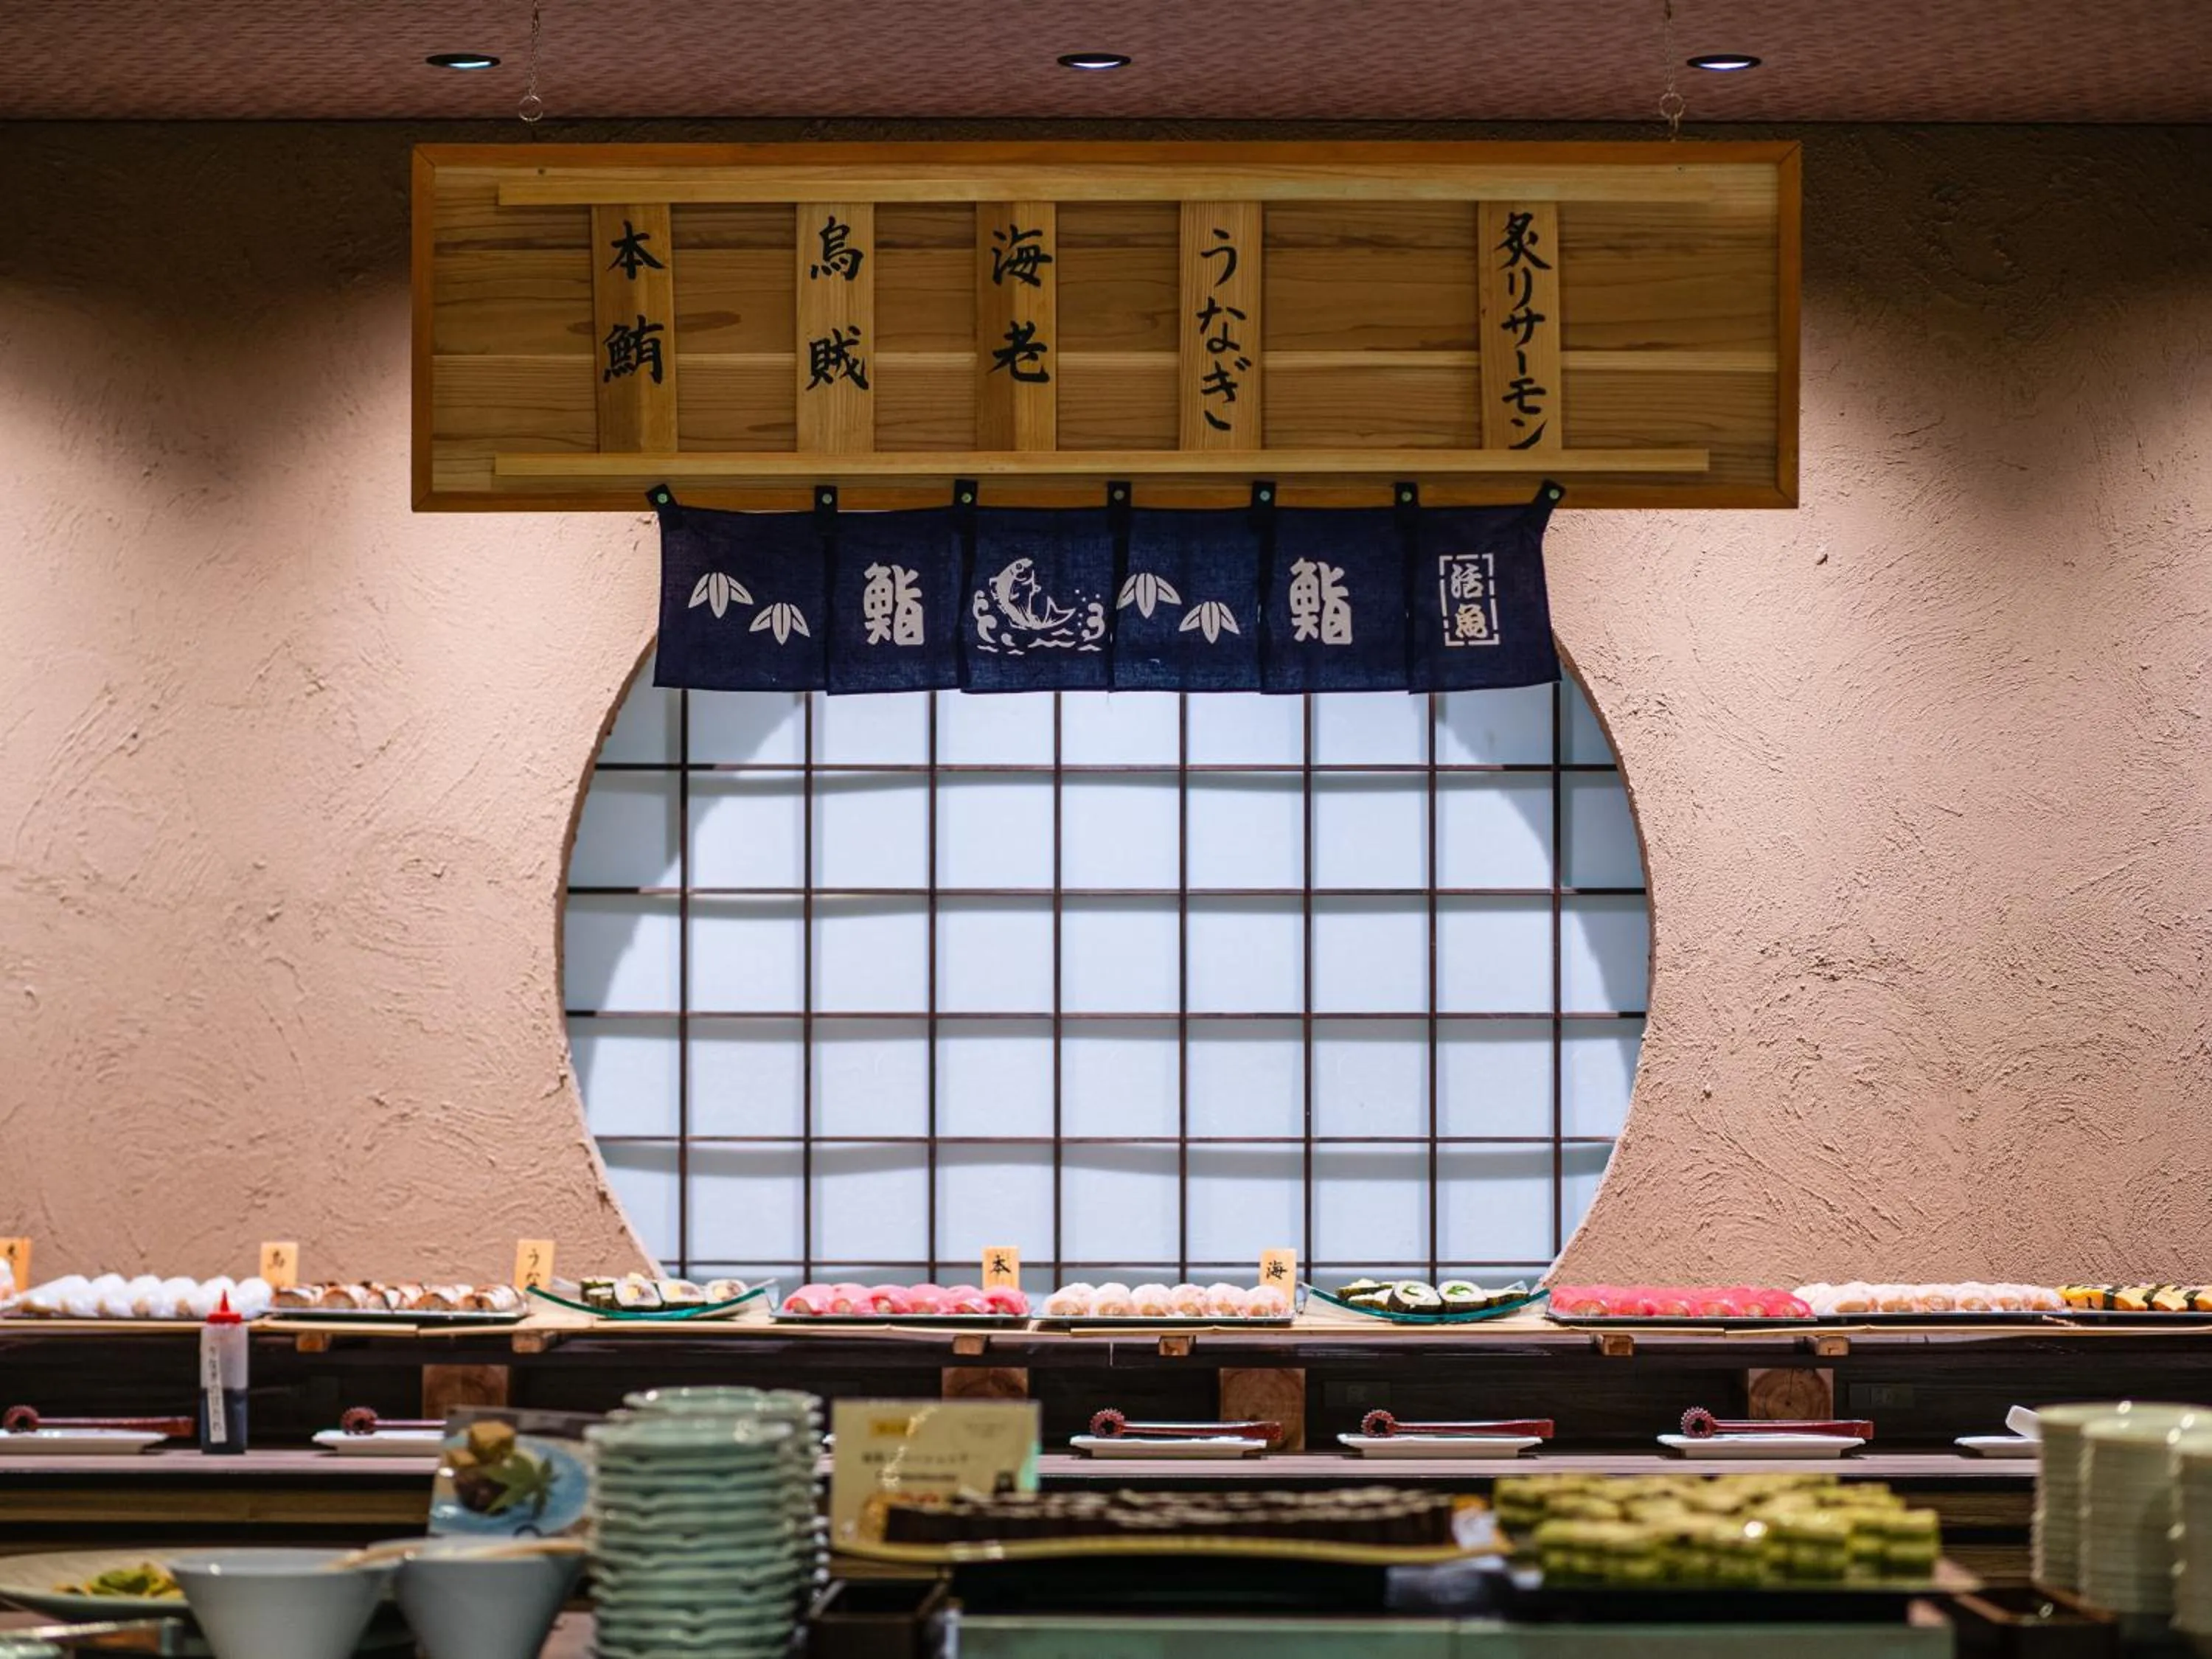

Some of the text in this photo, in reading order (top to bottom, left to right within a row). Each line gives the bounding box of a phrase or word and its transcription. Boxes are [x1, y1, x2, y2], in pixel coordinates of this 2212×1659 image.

[601, 218, 666, 386] 本鮪
[806, 215, 870, 391] 烏賊
[987, 223, 1054, 384] 海老
[1195, 228, 1253, 433] うなぎ
[1494, 210, 1553, 451] 炙りサーモン
[863, 561, 925, 646] 鮨
[1289, 557, 1352, 645] 鮨
[990, 1254, 1012, 1276] 本
